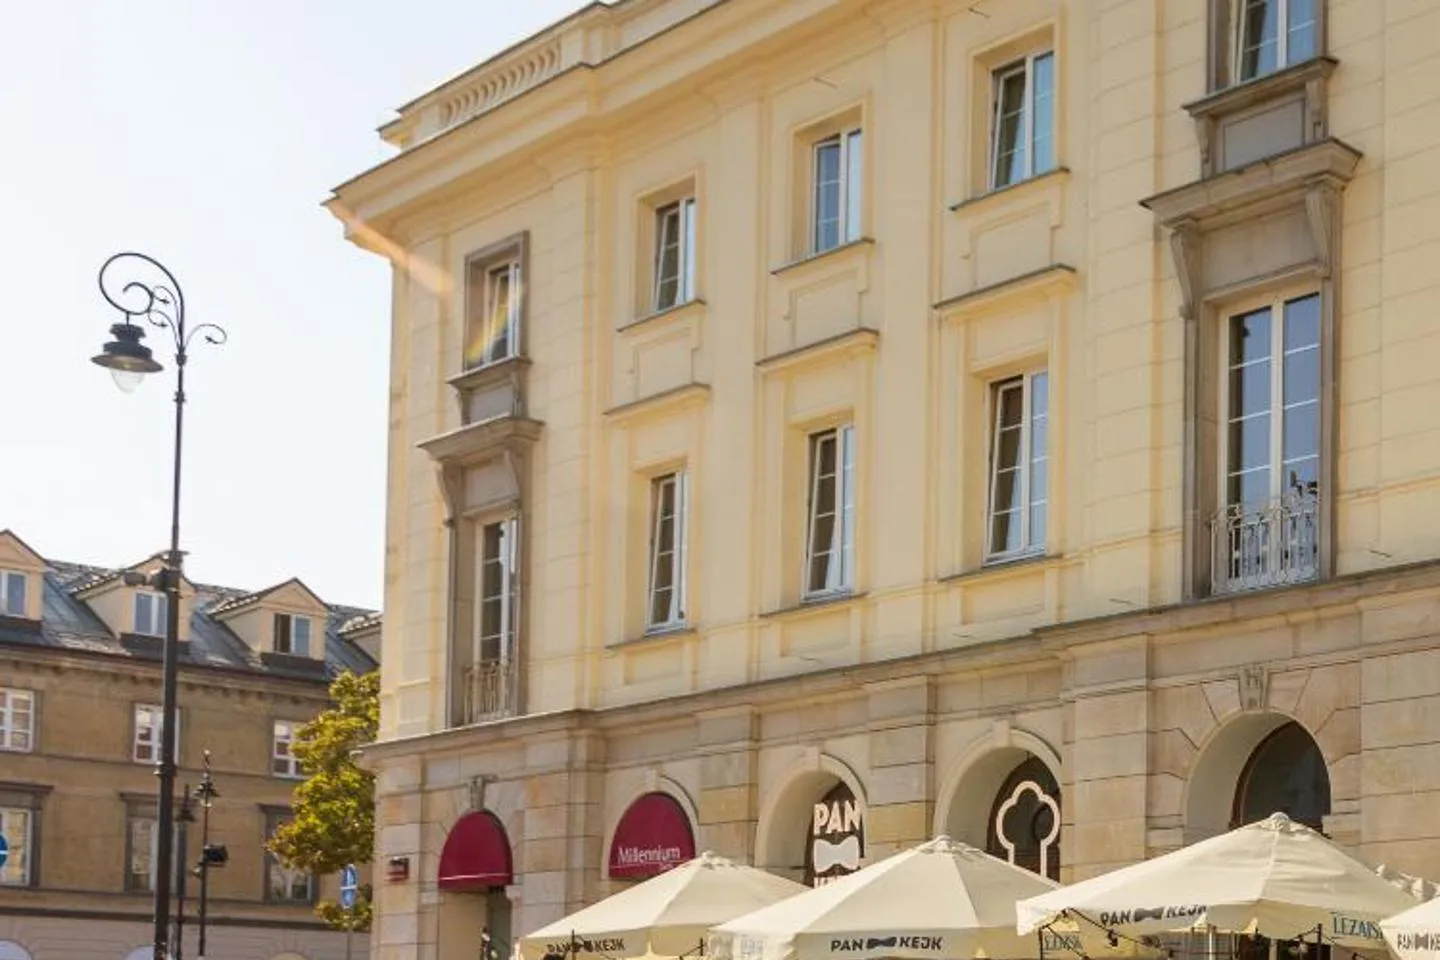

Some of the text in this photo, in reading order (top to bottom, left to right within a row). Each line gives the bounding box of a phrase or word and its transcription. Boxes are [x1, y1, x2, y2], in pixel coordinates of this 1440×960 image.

[813, 799, 861, 836] PAN
[617, 844, 681, 865] Millennium
[1099, 909, 1132, 926] PAN
[595, 938, 625, 953] KEJK
[830, 935, 943, 952] PAN KEJK
